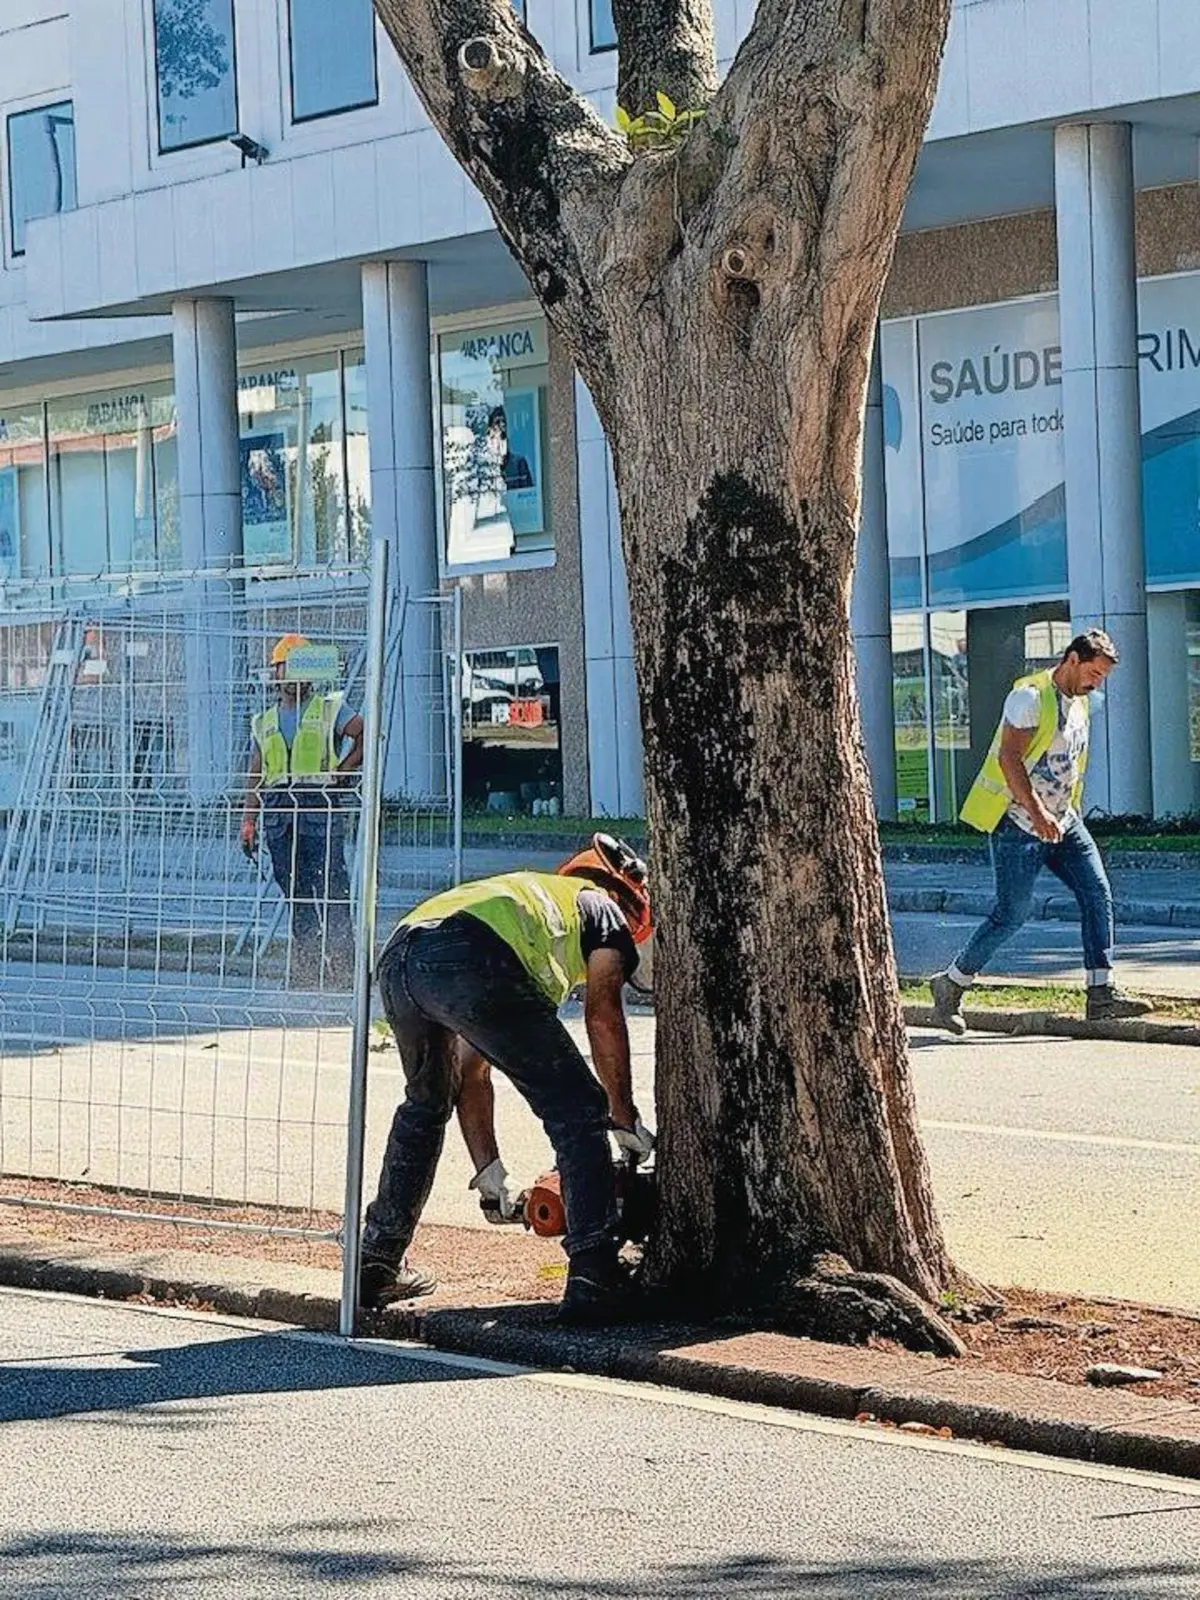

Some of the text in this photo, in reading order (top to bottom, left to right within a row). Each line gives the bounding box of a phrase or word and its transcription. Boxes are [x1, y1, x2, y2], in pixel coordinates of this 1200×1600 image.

[462, 330, 534, 360] ABANCA
[929, 346, 1062, 404] SAÚDE
[931, 417, 984, 446] Saúde
[990, 418, 1027, 444] para
